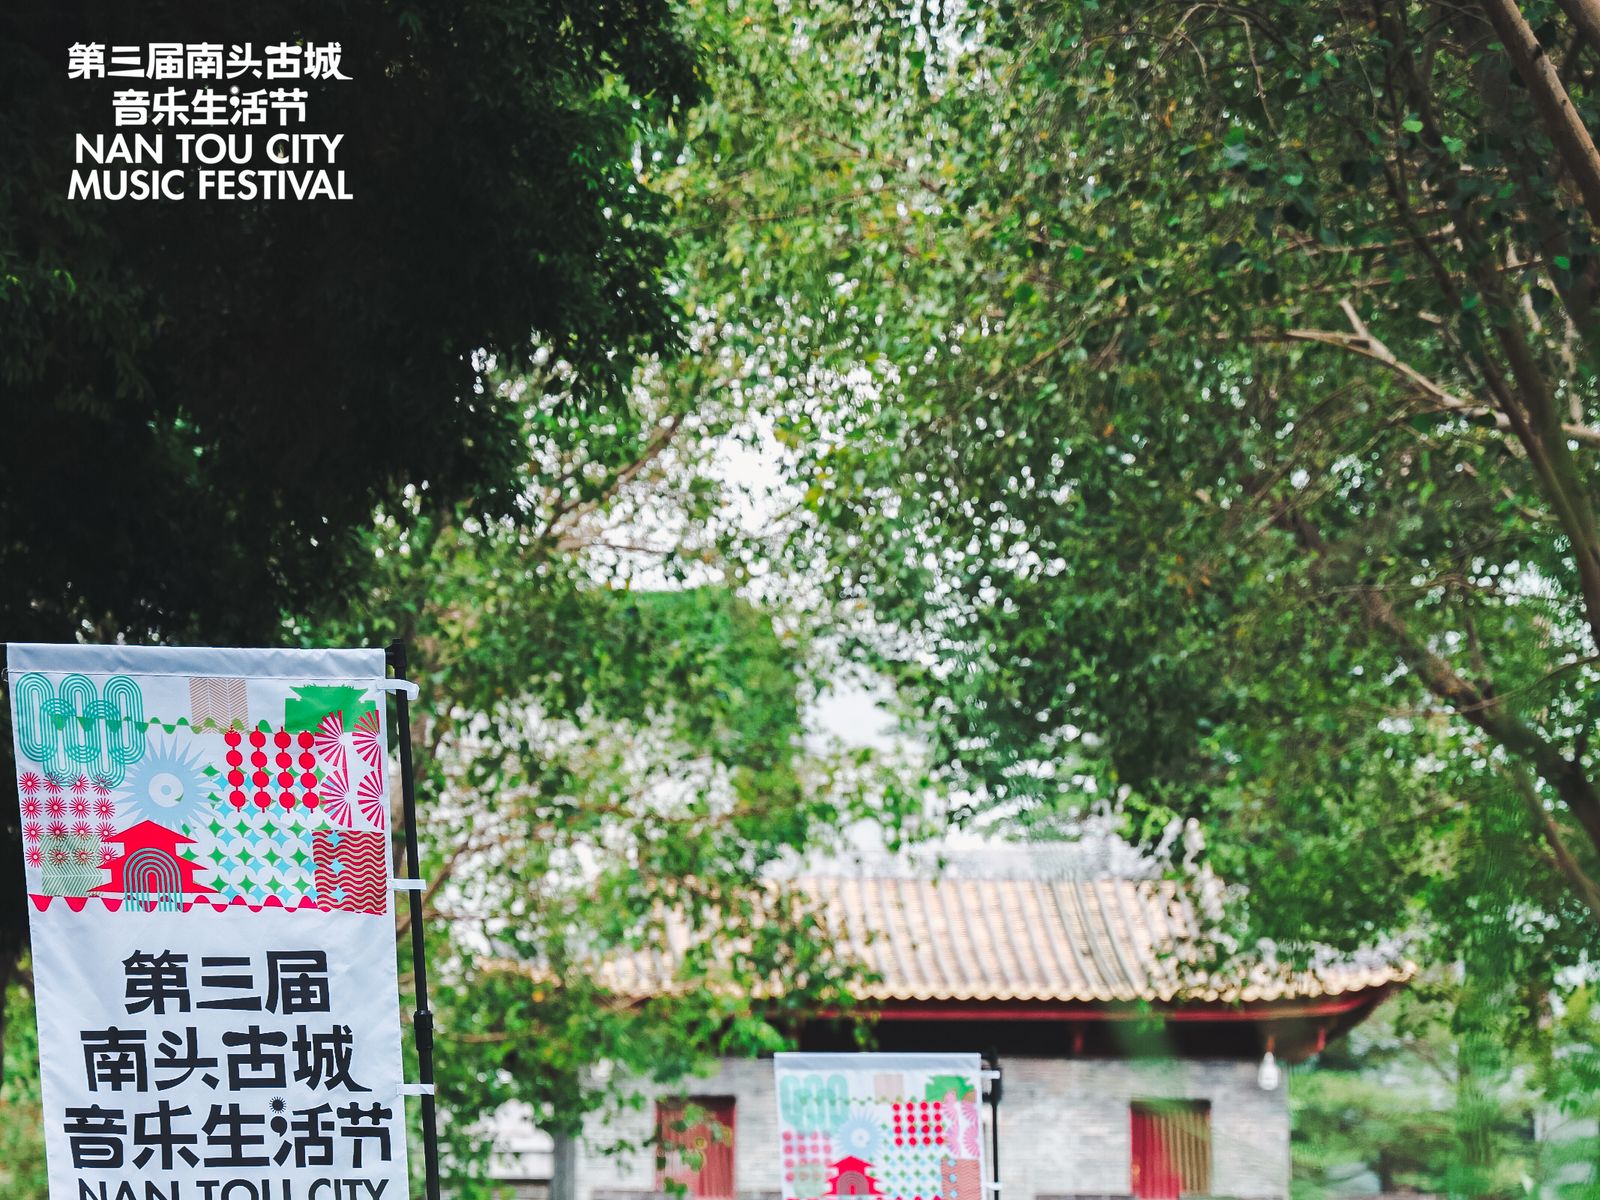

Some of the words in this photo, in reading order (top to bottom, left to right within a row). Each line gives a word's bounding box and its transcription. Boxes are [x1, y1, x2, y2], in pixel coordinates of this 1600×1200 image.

[121, 949, 332, 1015] 第三届
[79, 1024, 373, 1093] 南头古城
[63, 1096, 393, 1170] 音乐生活节
